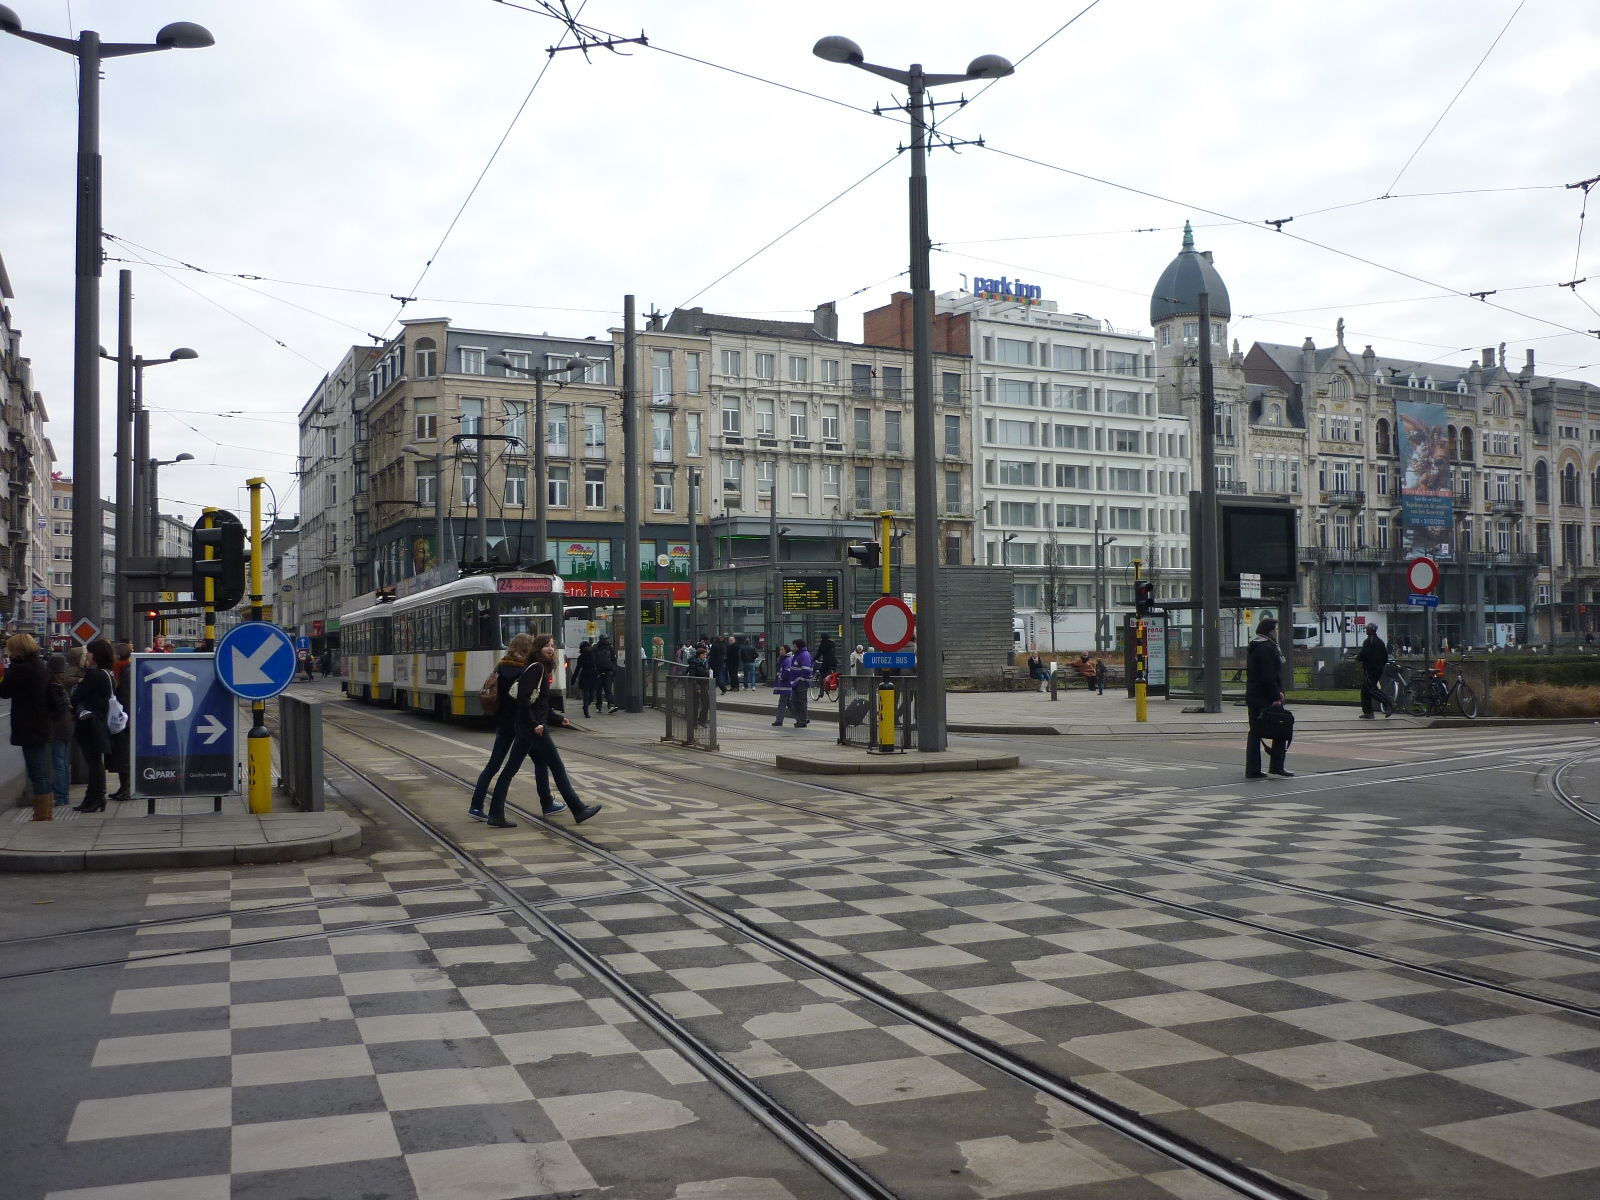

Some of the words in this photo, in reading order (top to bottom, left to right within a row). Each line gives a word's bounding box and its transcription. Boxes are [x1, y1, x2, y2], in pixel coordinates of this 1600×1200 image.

[974, 276, 1013, 297] park
[1015, 278, 1041, 298] inn
[499, 579, 512, 591] 24
[1324, 616, 1351, 634] LIVE
[895, 656, 908, 664] BUS
[151, 684, 194, 746] P
